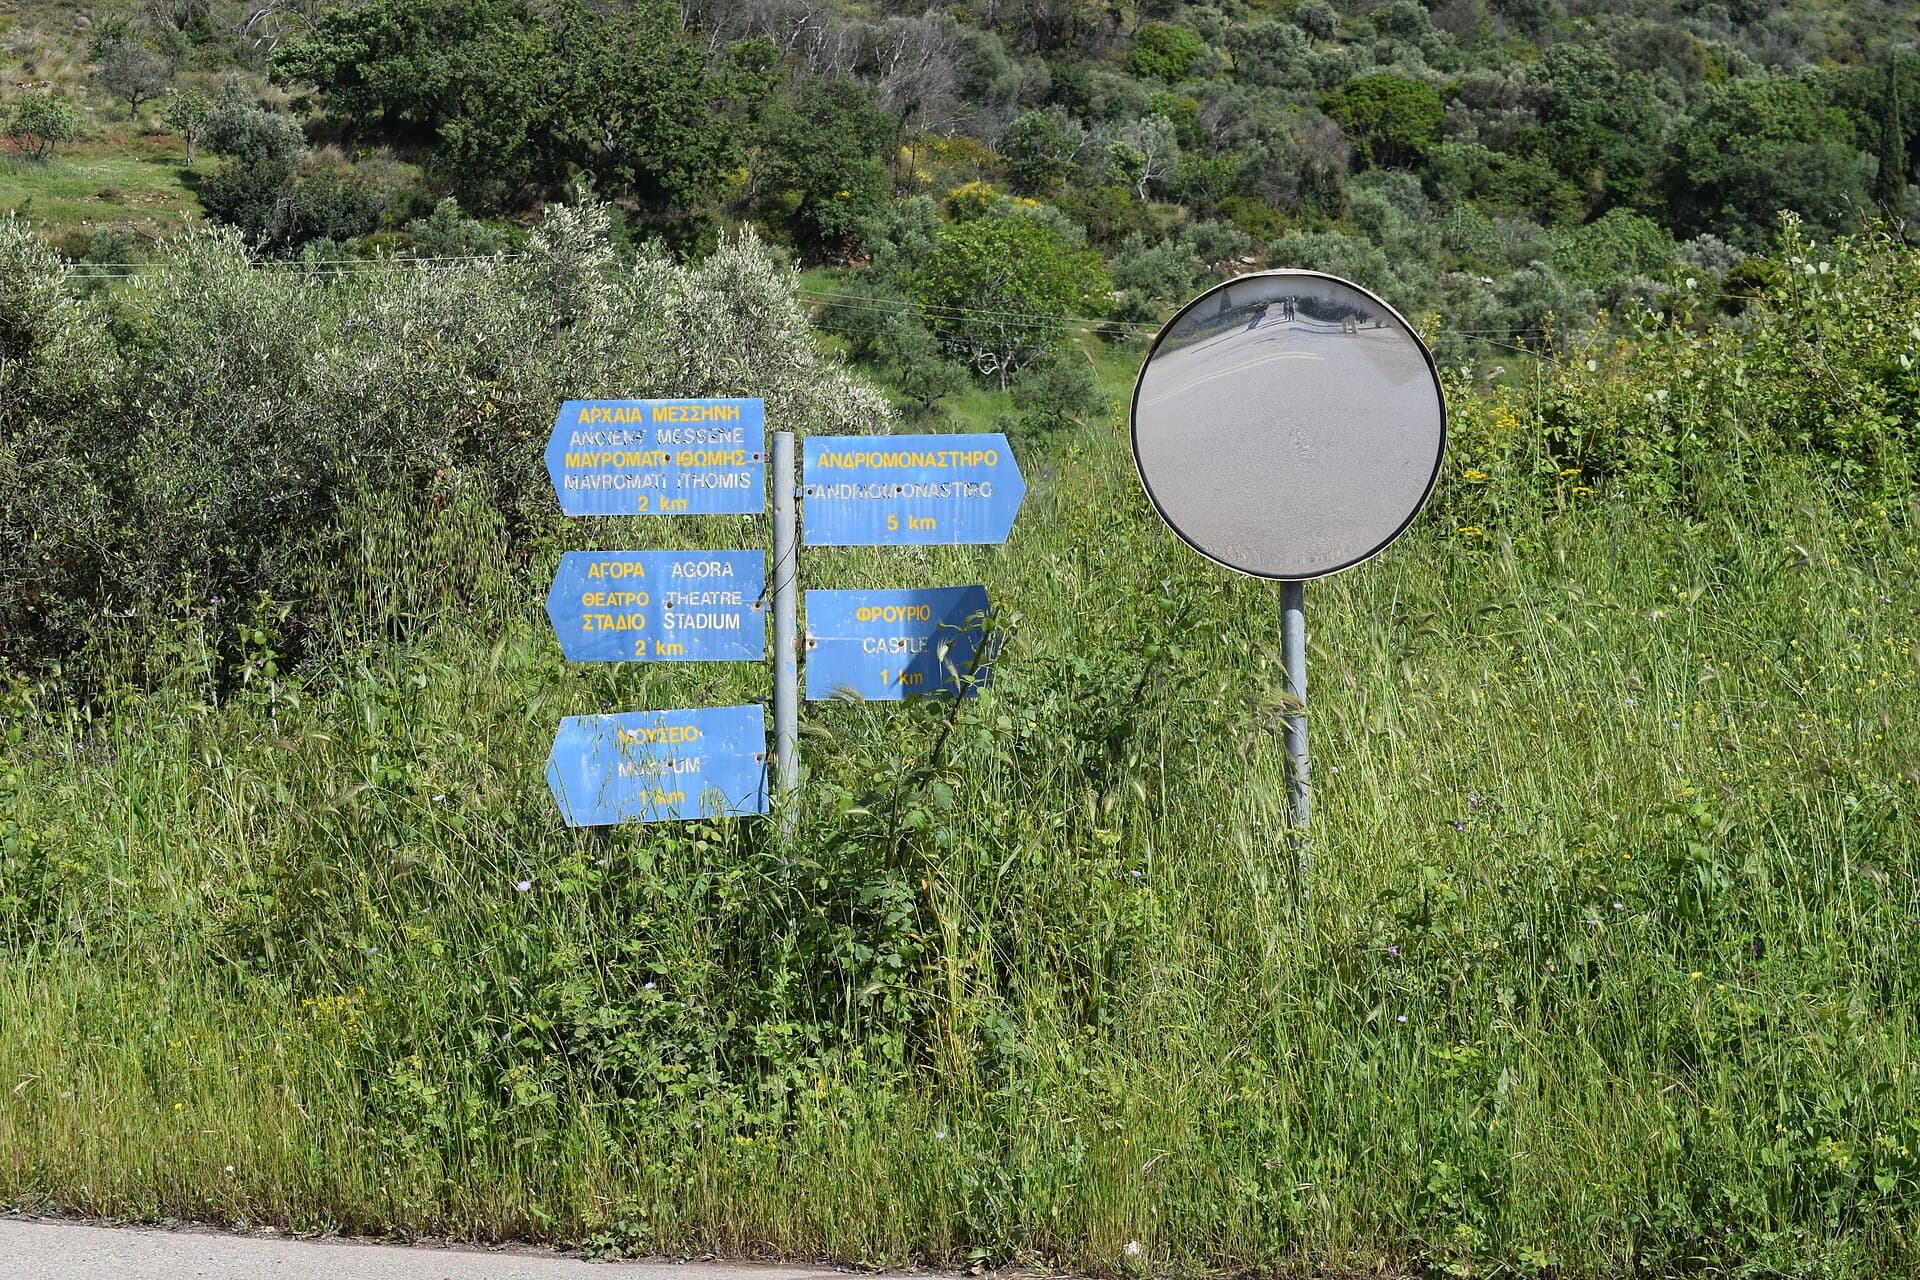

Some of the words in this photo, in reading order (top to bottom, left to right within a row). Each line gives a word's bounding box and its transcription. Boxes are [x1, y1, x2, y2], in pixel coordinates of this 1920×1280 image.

[578, 407, 642, 424] ΑΡΧΑΙΑ
[653, 405, 740, 423] ΜΕΣΣΗΝΗ
[569, 428, 647, 446] ANCIENT
[656, 427, 745, 445] MESSENE
[565, 450, 667, 469] ΜΑΥΡΟΜΑΤΙ
[676, 449, 747, 467] ΙΘΩΜΗΣ
[817, 449, 998, 469] ΑΝΔΡΙΟΜΟΝΑΣΤΗΡΟ
[564, 473, 667, 490] MAVROMATI
[677, 472, 751, 489] ITHOMIS
[637, 496, 649, 512] 2
[659, 495, 688, 511] km
[887, 515, 899, 531] 5
[909, 514, 937, 531] km
[588, 561, 645, 579] ΑΓΟΡΑ
[671, 561, 734, 578] AGORA
[582, 591, 649, 607] ΘΕΑΤΡΟ
[666, 590, 743, 606] THEATRE
[582, 613, 646, 630] ΣΤΑΔΙΟ
[663, 612, 740, 630] STADIUM
[855, 604, 931, 623] ΦΡΟΥΡΙΟ
[635, 640, 647, 657] 2
[656, 640, 684, 656] km
[863, 636, 928, 654] CASTLE
[880, 669, 889, 686] 1
[898, 669, 924, 686] km
[639, 790, 647, 806] 1
